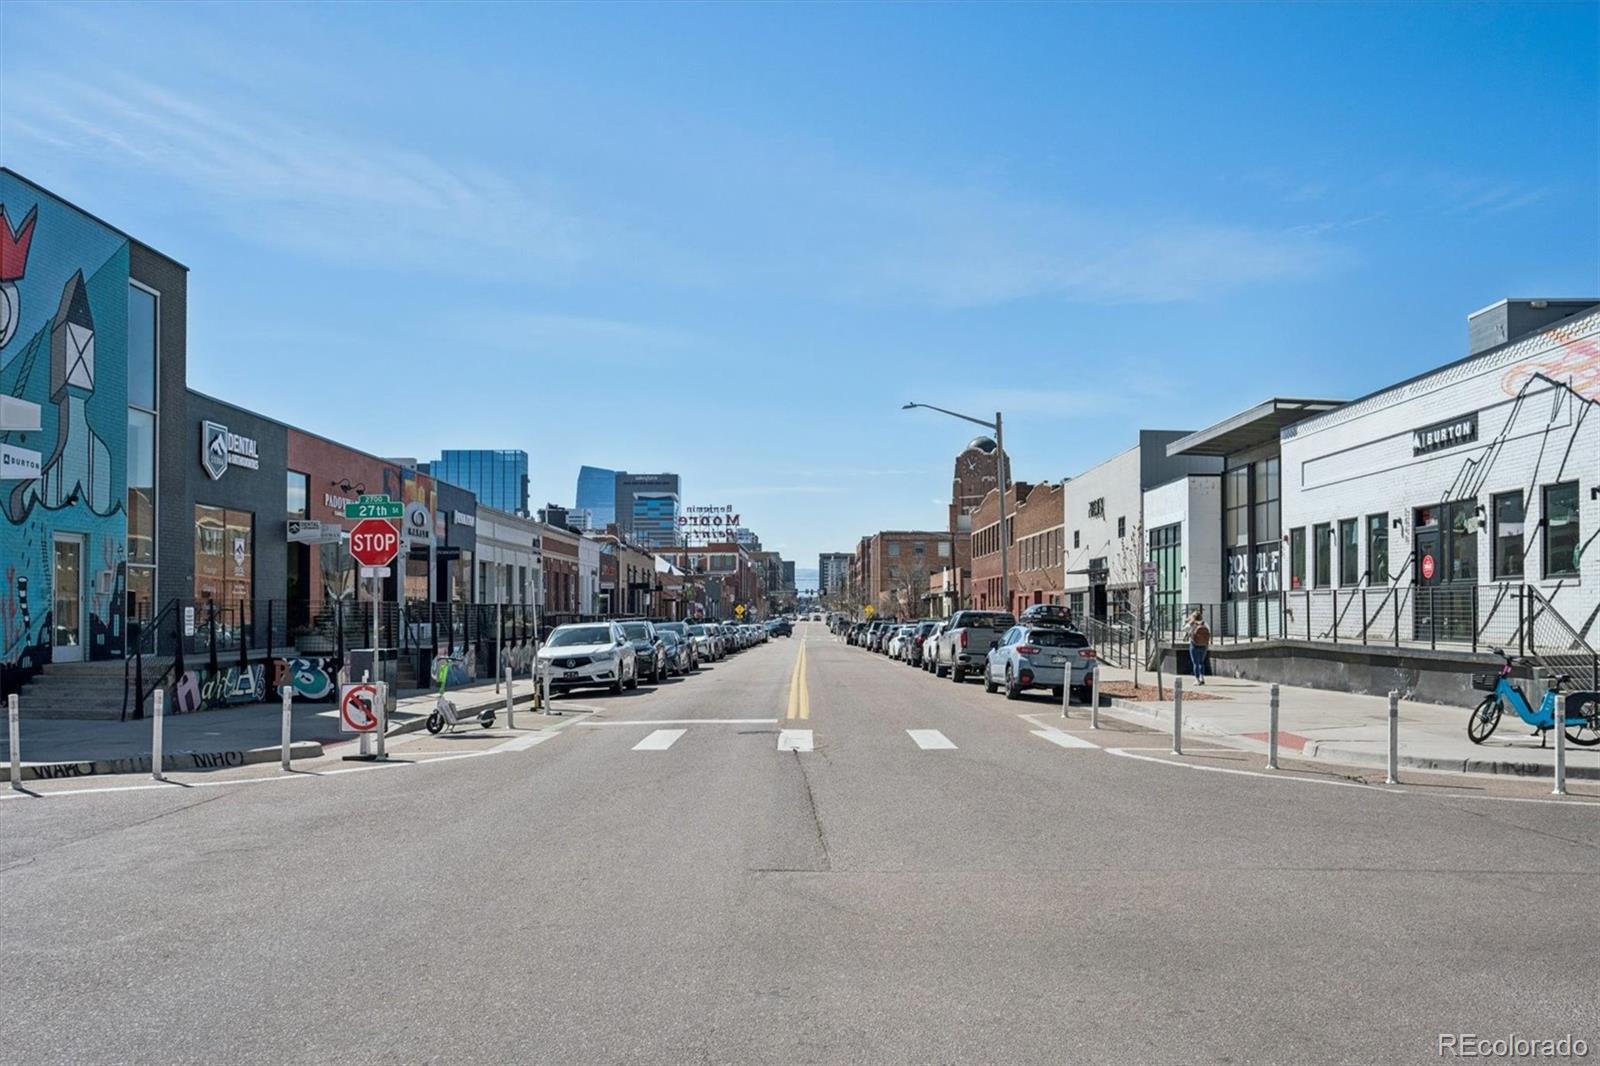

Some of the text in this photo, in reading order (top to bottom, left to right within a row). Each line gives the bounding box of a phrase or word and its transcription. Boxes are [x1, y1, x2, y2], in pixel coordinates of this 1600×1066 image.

[1427, 421, 1470, 445] BURTON
[228, 432, 259, 458] DENTAL
[11, 457, 40, 469] BURTON
[359, 505, 400, 517] 27th St
[353, 533, 396, 552] STOP
